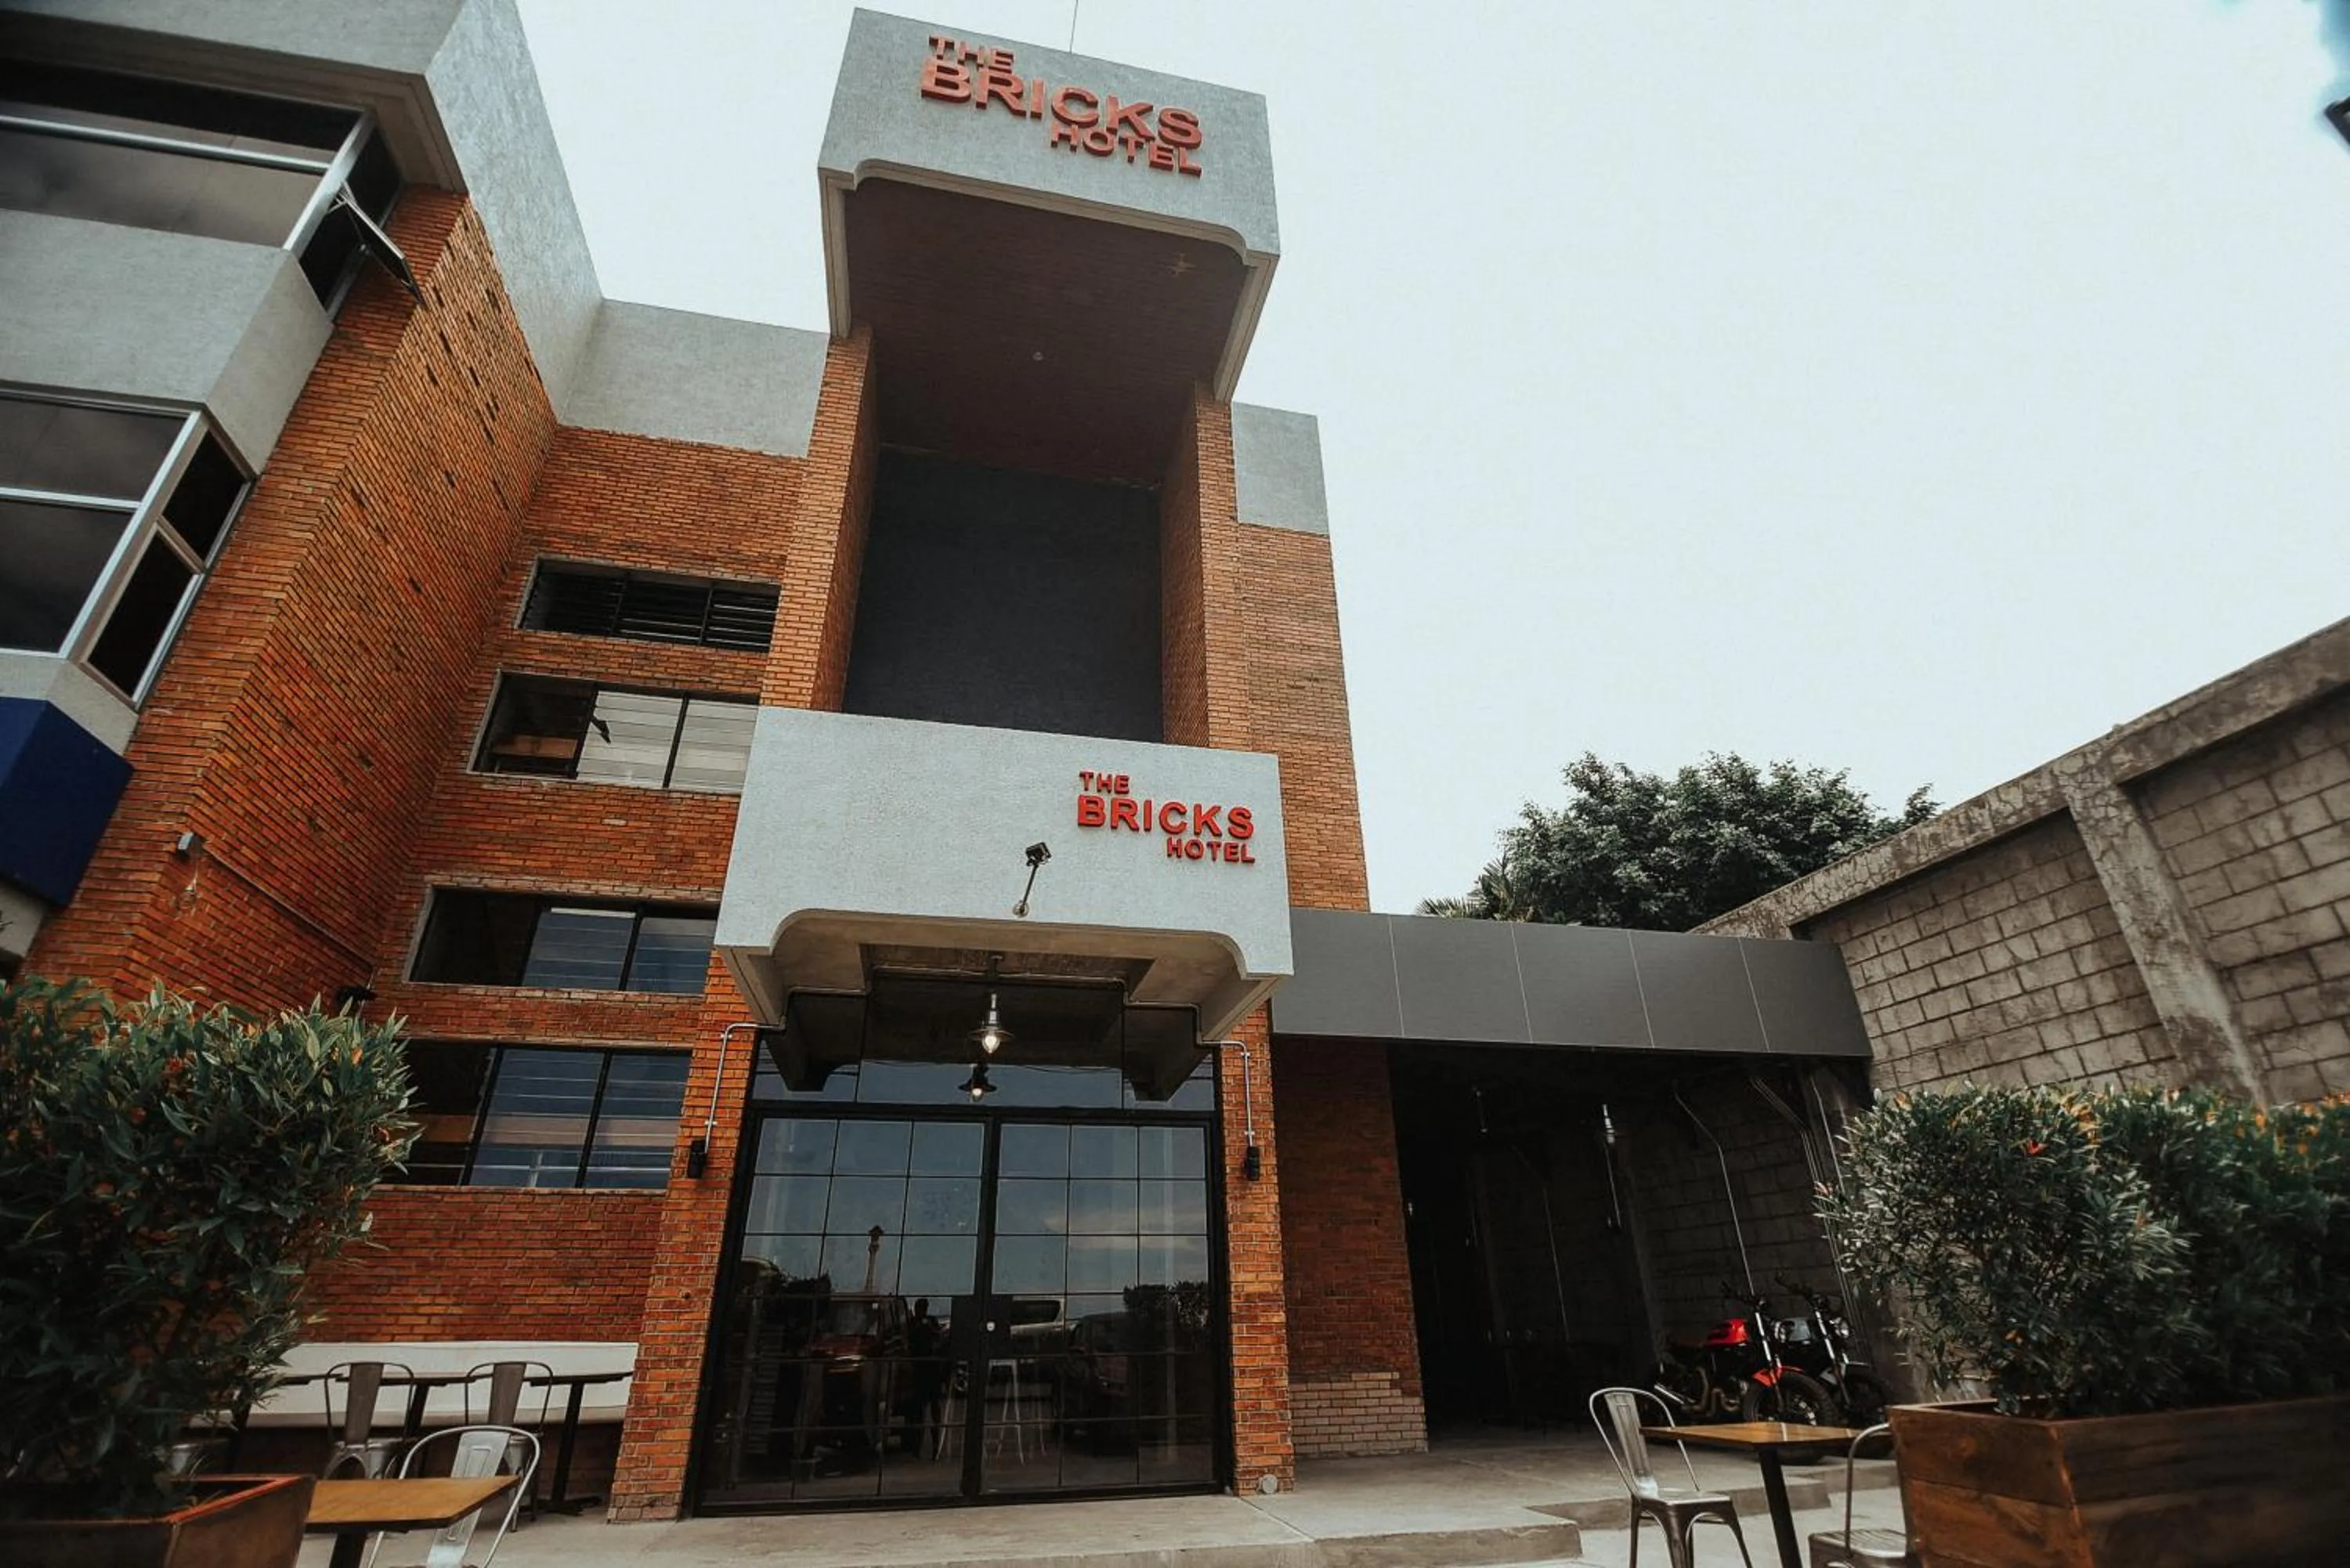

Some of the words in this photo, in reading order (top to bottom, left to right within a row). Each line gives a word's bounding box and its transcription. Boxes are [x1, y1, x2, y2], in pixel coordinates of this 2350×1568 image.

[929, 34, 1014, 74] THE
[920, 58, 1203, 150] BRICKS
[1050, 121, 1202, 179] HOTEL
[1079, 771, 1130, 795] THE
[1076, 794, 1255, 839] BRICKS
[1166, 836, 1256, 864] HOTEL
